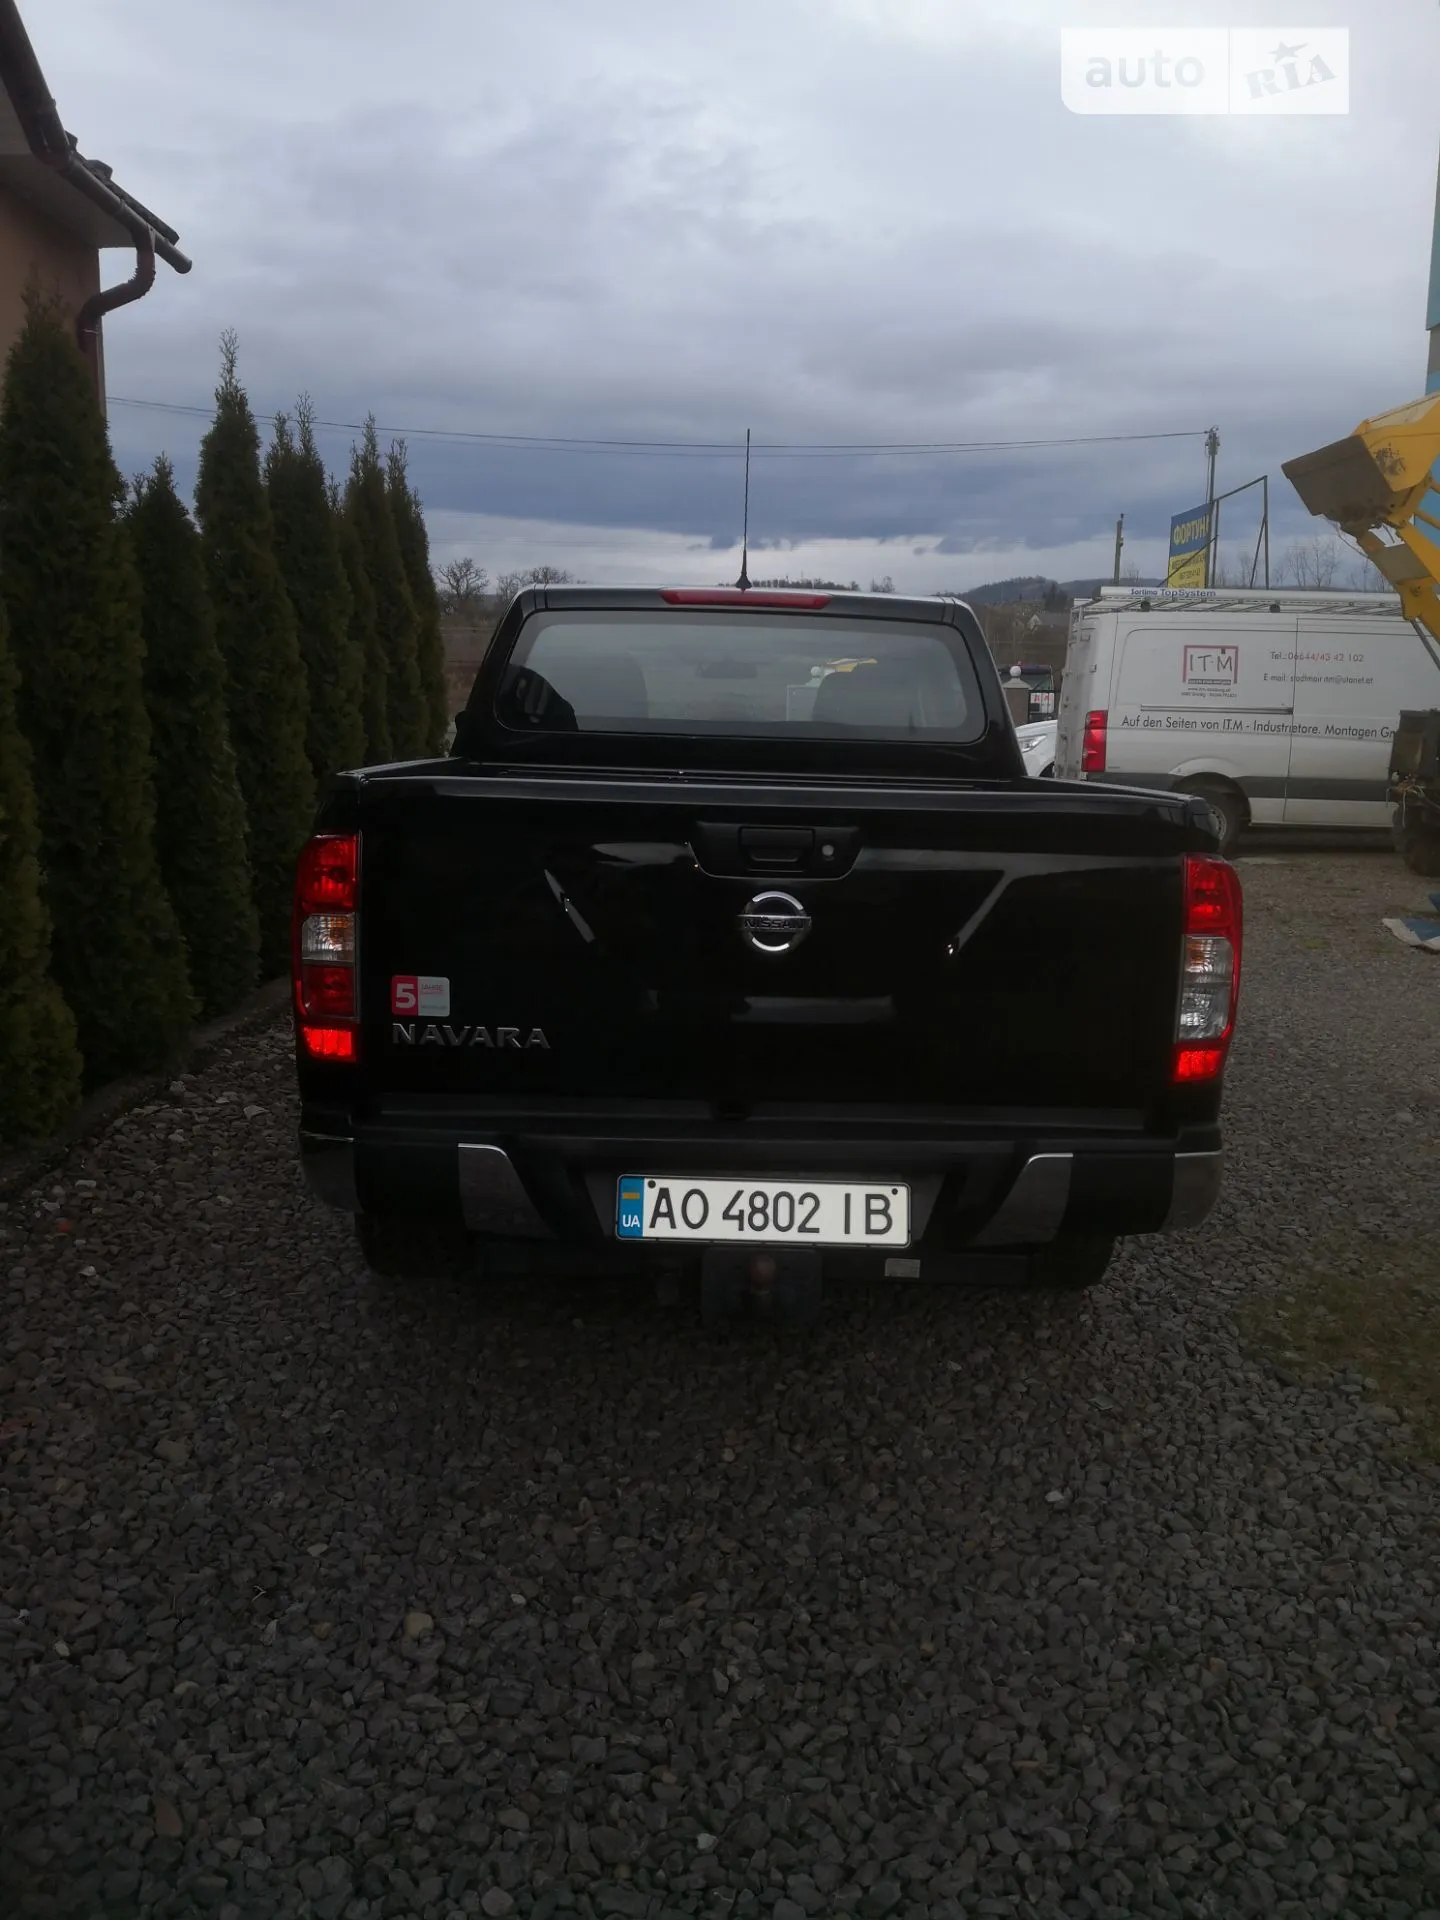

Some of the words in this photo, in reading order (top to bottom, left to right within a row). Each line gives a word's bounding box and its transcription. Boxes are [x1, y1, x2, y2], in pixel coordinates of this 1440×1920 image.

[1159, 588, 1217, 598] TopSystem
[1121, 715, 1141, 728] Auf
[1142, 716, 1162, 728] den
[1165, 717, 1197, 730] Seiten
[1200, 721, 1219, 730] von
[1324, 724, 1377, 739] Montagen
[395, 983, 416, 1009] 5
[392, 1022, 551, 1049] NAVARA
[622, 1214, 640, 1228] UA
[649, 1187, 709, 1230] AO
[722, 1189, 820, 1233] 4802
[843, 1192, 893, 1235] IB
